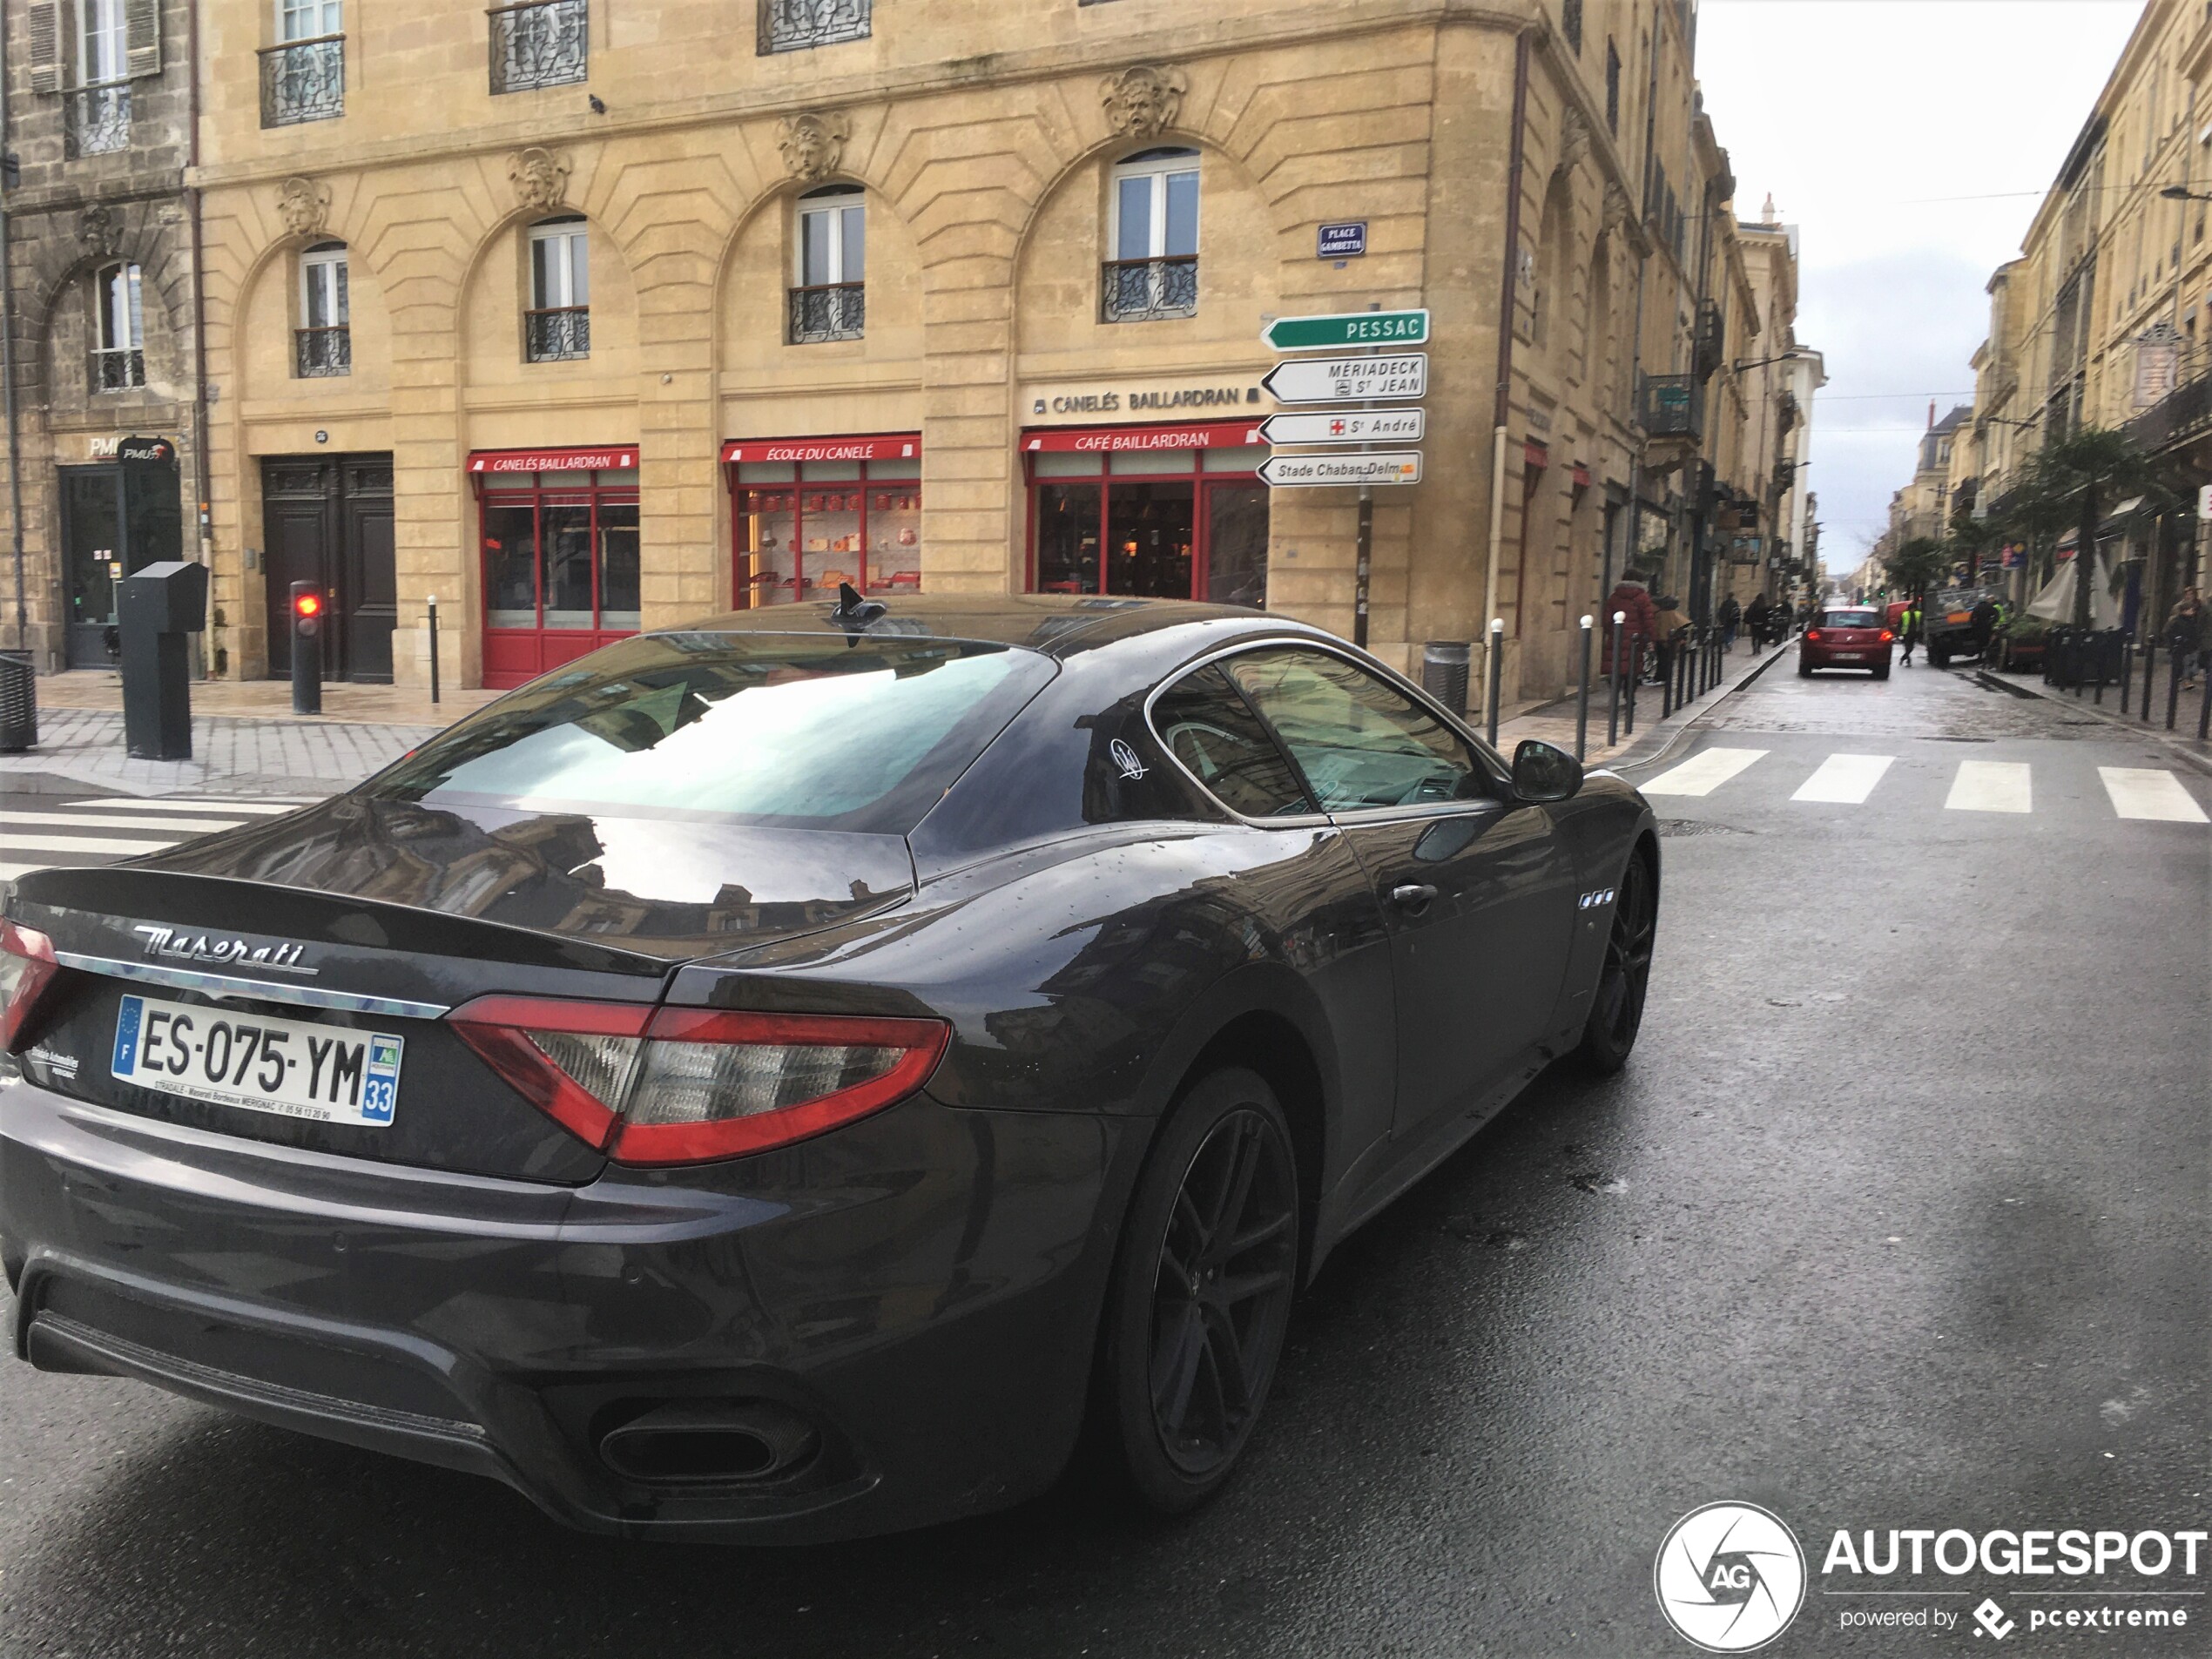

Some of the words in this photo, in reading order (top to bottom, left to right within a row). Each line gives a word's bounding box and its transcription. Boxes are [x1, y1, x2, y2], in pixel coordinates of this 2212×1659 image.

[1328, 227, 1356, 239] PLACE
[1346, 318, 1420, 340] PESSAC
[1328, 361, 1420, 378] MÉRIADECK
[1379, 378, 1420, 393] JEAN
[1053, 392, 1119, 413] CANELÉS
[1130, 388, 1239, 410] BAILLARDRAN
[1372, 418, 1417, 433] André
[1075, 435, 1112, 450] CAFÉ
[1112, 432, 1210, 450] BAILLARDRAN
[124, 448, 153, 460] PMU
[766, 447, 804, 461] ÉCOLE
[805, 448, 826, 460] DU
[826, 443, 873, 460] CANELÉ
[493, 456, 537, 471] CANELÉS
[538, 455, 611, 470] BAILLARDRAN
[1278, 463, 1312, 477] Stade
[1317, 461, 1405, 476] Chaban-Delm
[134, 926, 320, 975] Maserati
[120, 1043, 131, 1061] F
[141, 1009, 366, 1107] ES-075-YM
[366, 1080, 394, 1112] 33
